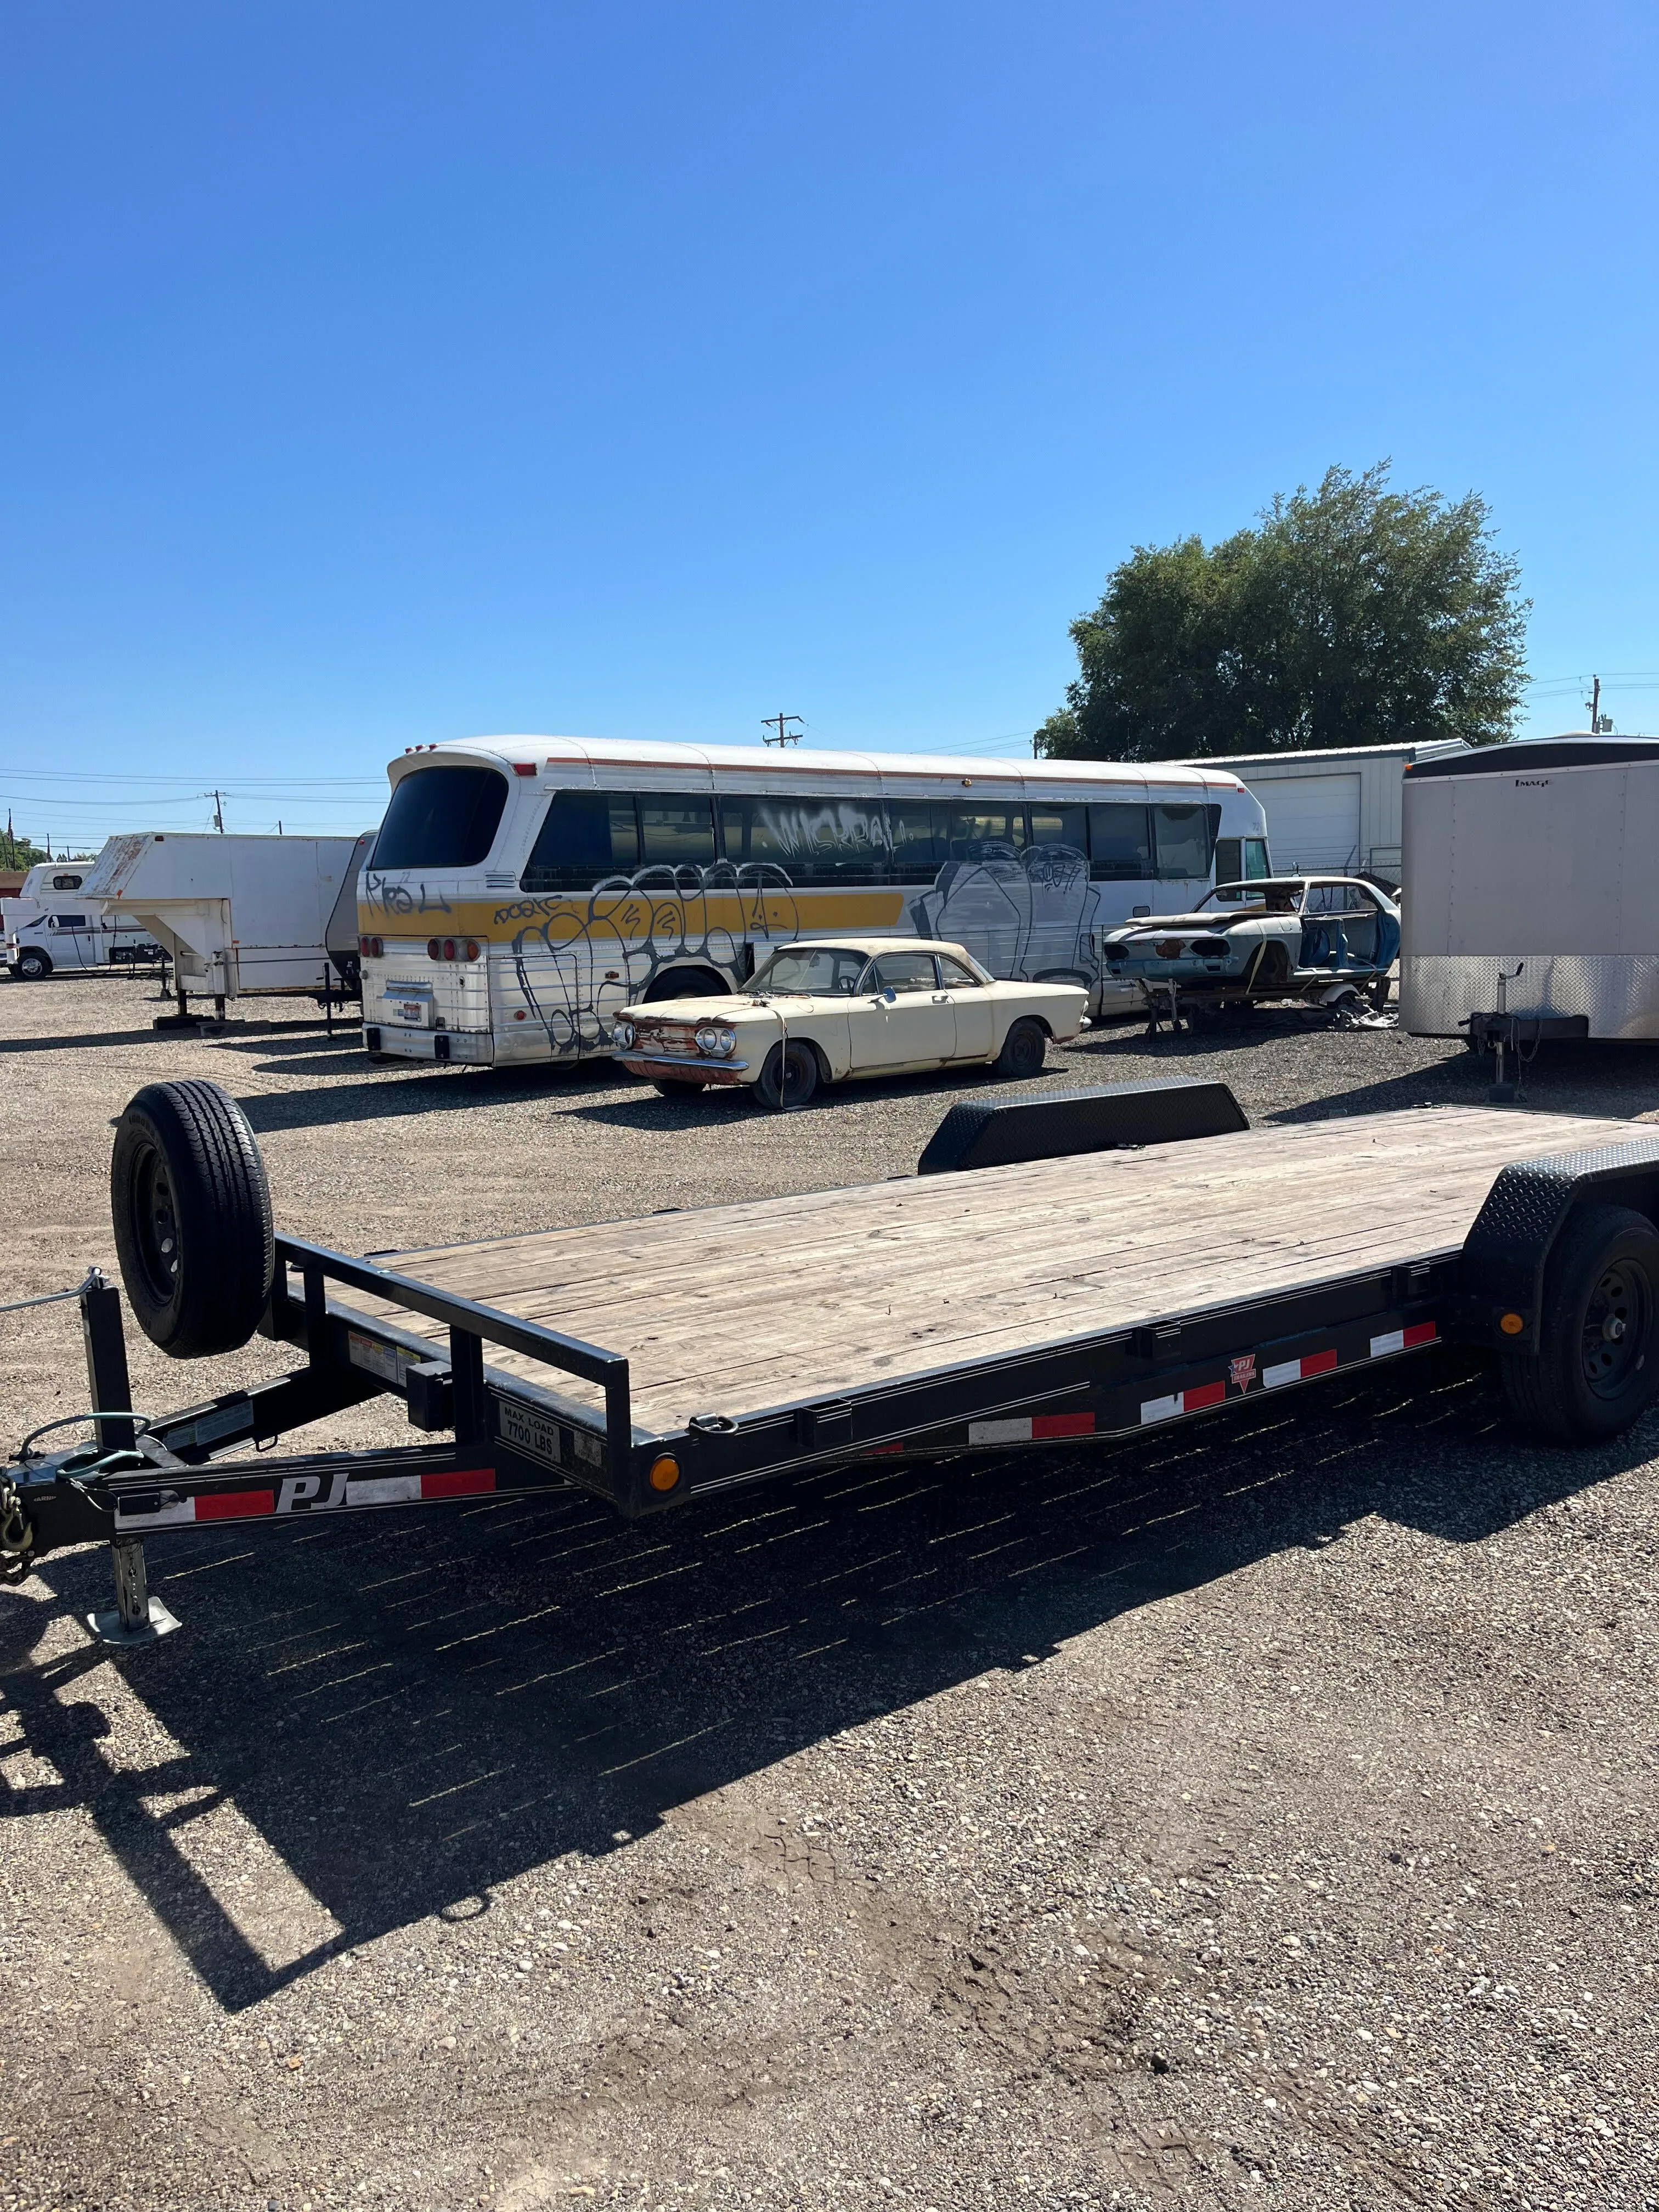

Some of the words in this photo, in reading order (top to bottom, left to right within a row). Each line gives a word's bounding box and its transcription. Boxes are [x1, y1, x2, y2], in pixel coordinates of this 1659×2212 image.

[1233, 1372, 1255, 1381] TRAILERS
[1238, 1358, 1250, 1371] PJ
[504, 1407, 524, 1423] MAX
[528, 1417, 554, 1436] LOAD
[507, 1419, 531, 1444] 7700
[535, 1432, 552, 1455] LBS
[275, 1472, 349, 1514] PJ
